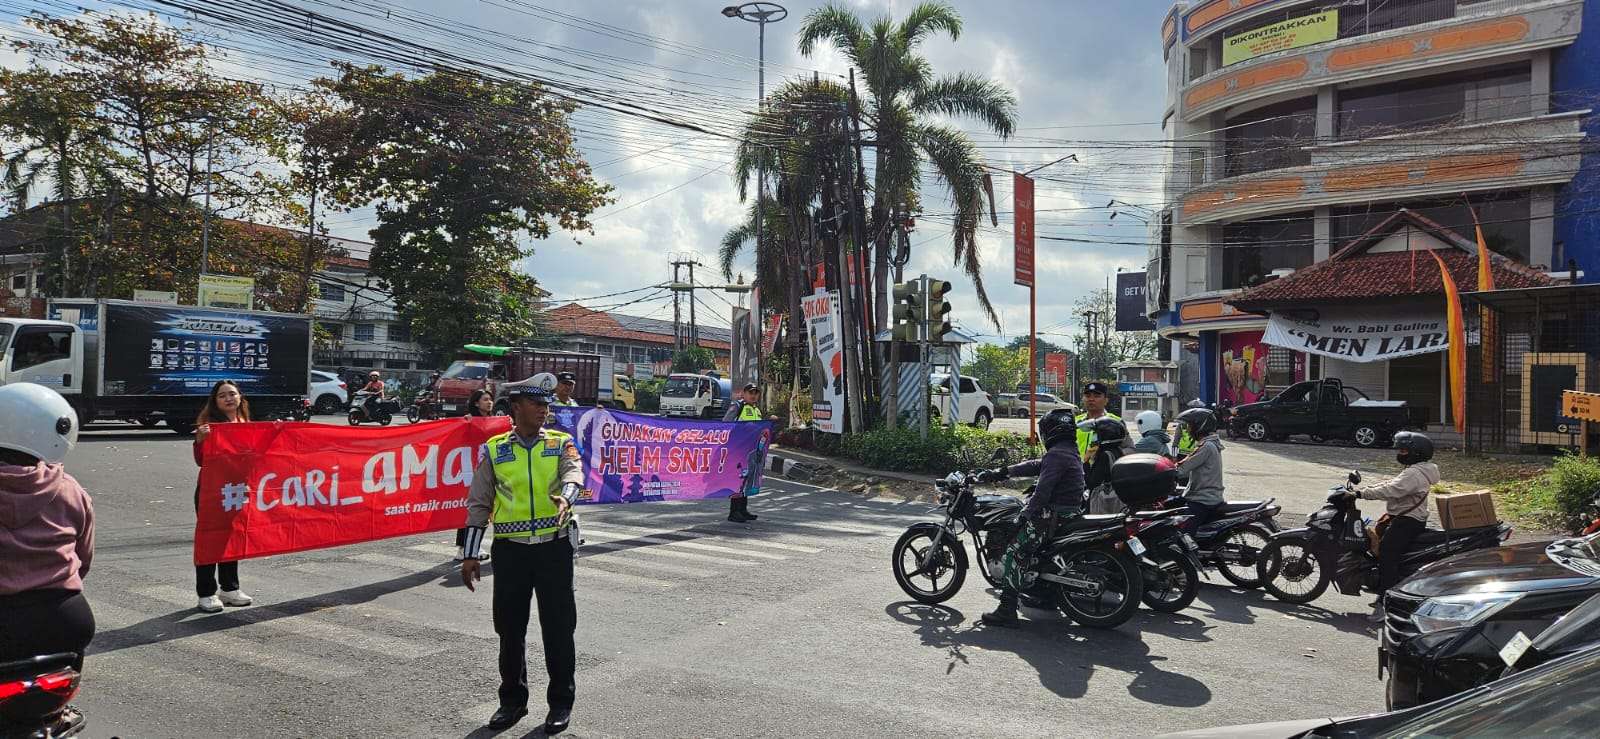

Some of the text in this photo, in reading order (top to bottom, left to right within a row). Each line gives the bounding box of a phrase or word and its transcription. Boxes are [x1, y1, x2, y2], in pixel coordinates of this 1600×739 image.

[1230, 15, 1326, 45] DIKONTRAKKAN
[1124, 286, 1138, 296] GET
[1357, 324, 1389, 333] Babi
[1393, 322, 1438, 332] Guling
[1376, 332, 1449, 356] LAR
[602, 422, 731, 444] GUNAKAN SELALU
[598, 446, 661, 475] HELM
[667, 447, 711, 474] SNI
[221, 443, 473, 512] #CaRi_aMa
[384, 503, 410, 516] saat
[413, 499, 440, 512] naik
